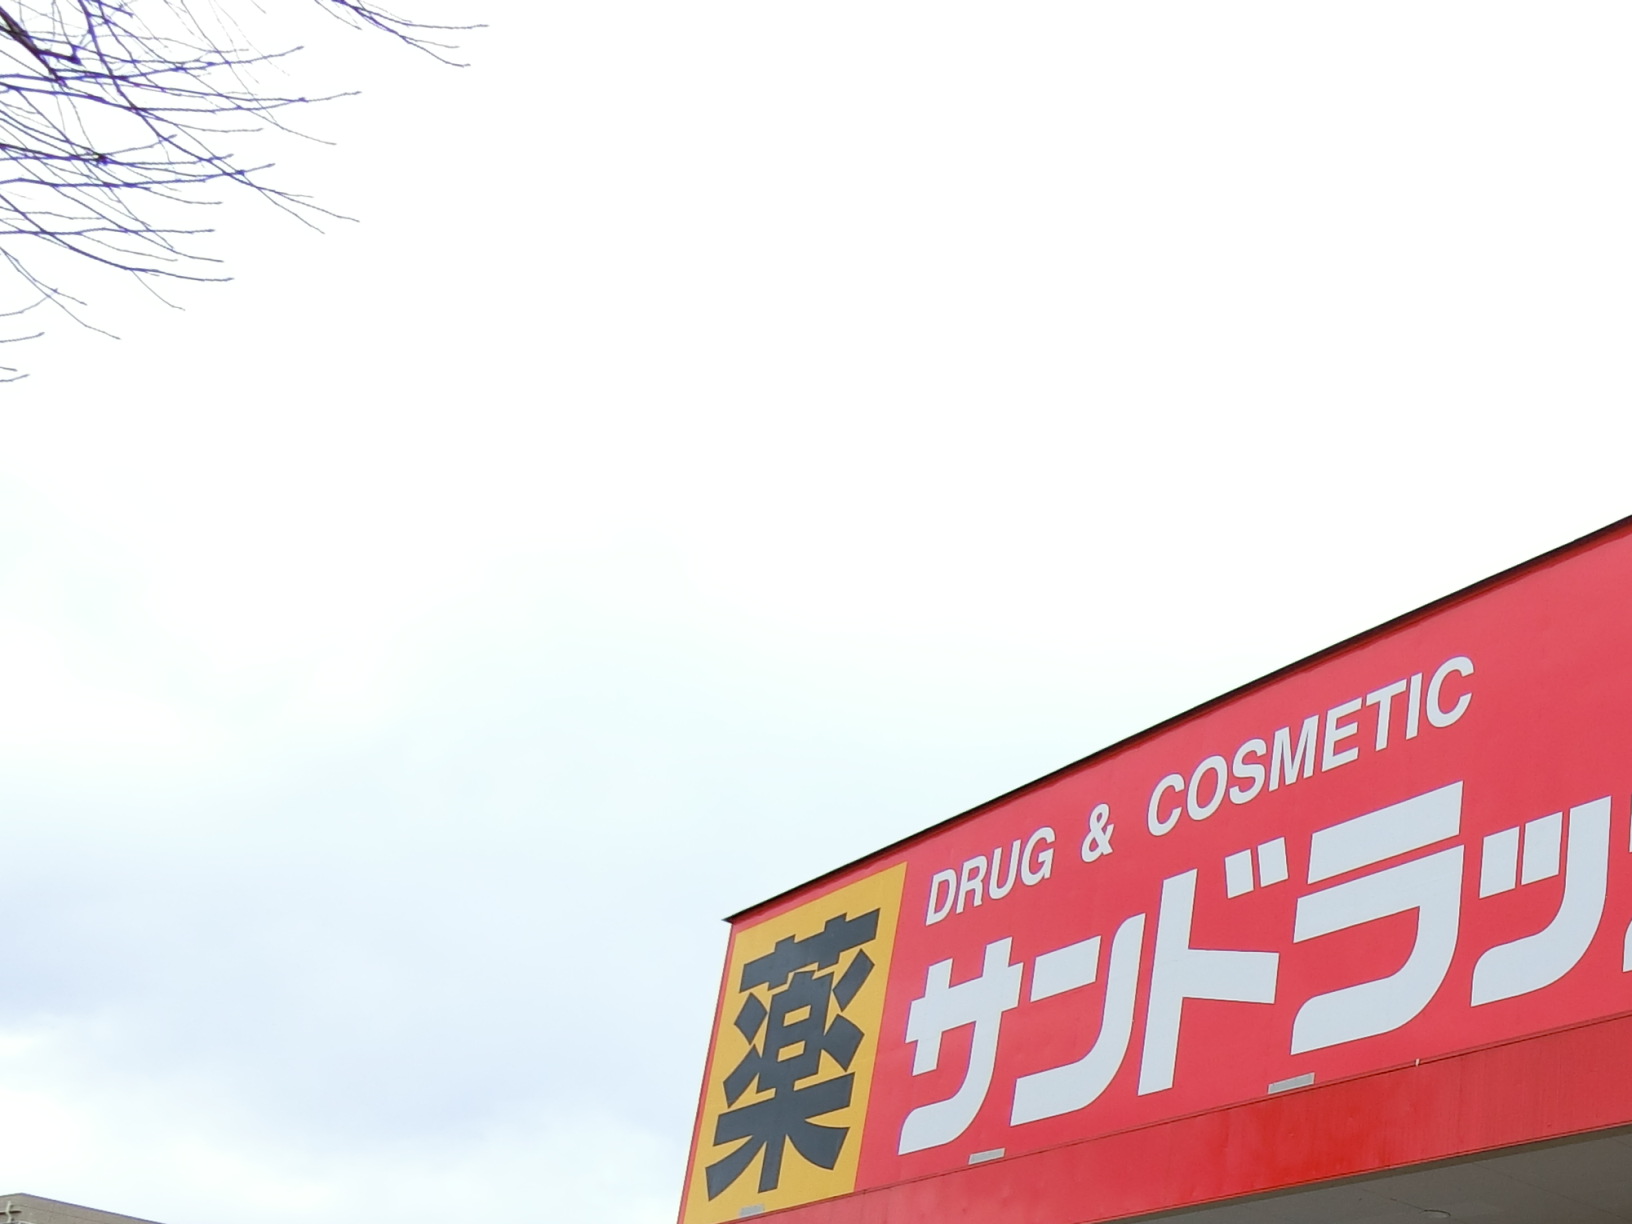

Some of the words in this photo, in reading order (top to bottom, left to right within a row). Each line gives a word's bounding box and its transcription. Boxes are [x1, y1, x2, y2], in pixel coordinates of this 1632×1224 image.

[926, 827, 1056, 927] DRUG
[1080, 812, 1115, 864] &
[1147, 655, 1475, 840] COSMETIC
[705, 907, 881, 1202] 薬
